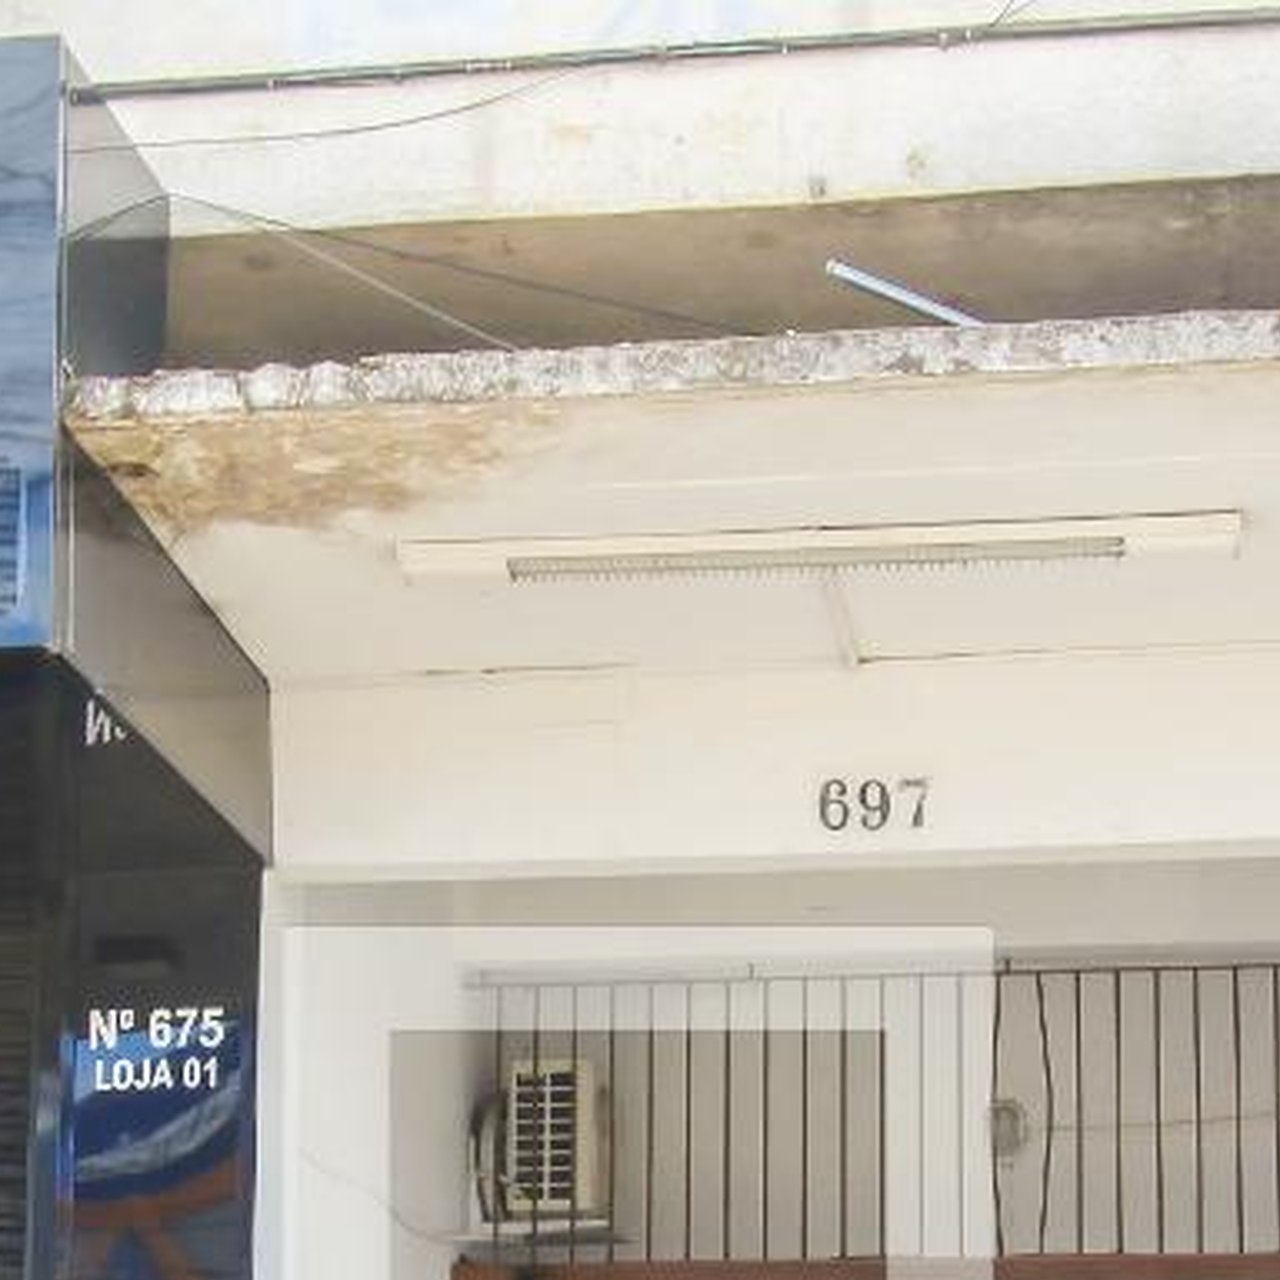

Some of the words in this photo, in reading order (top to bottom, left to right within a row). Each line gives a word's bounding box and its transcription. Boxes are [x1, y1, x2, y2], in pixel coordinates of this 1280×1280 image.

[820, 777, 930, 831] 697
[149, 1006, 225, 1048] 675
[95, 1058, 174, 1091] LOJA
[183, 1056, 219, 1089] 01
